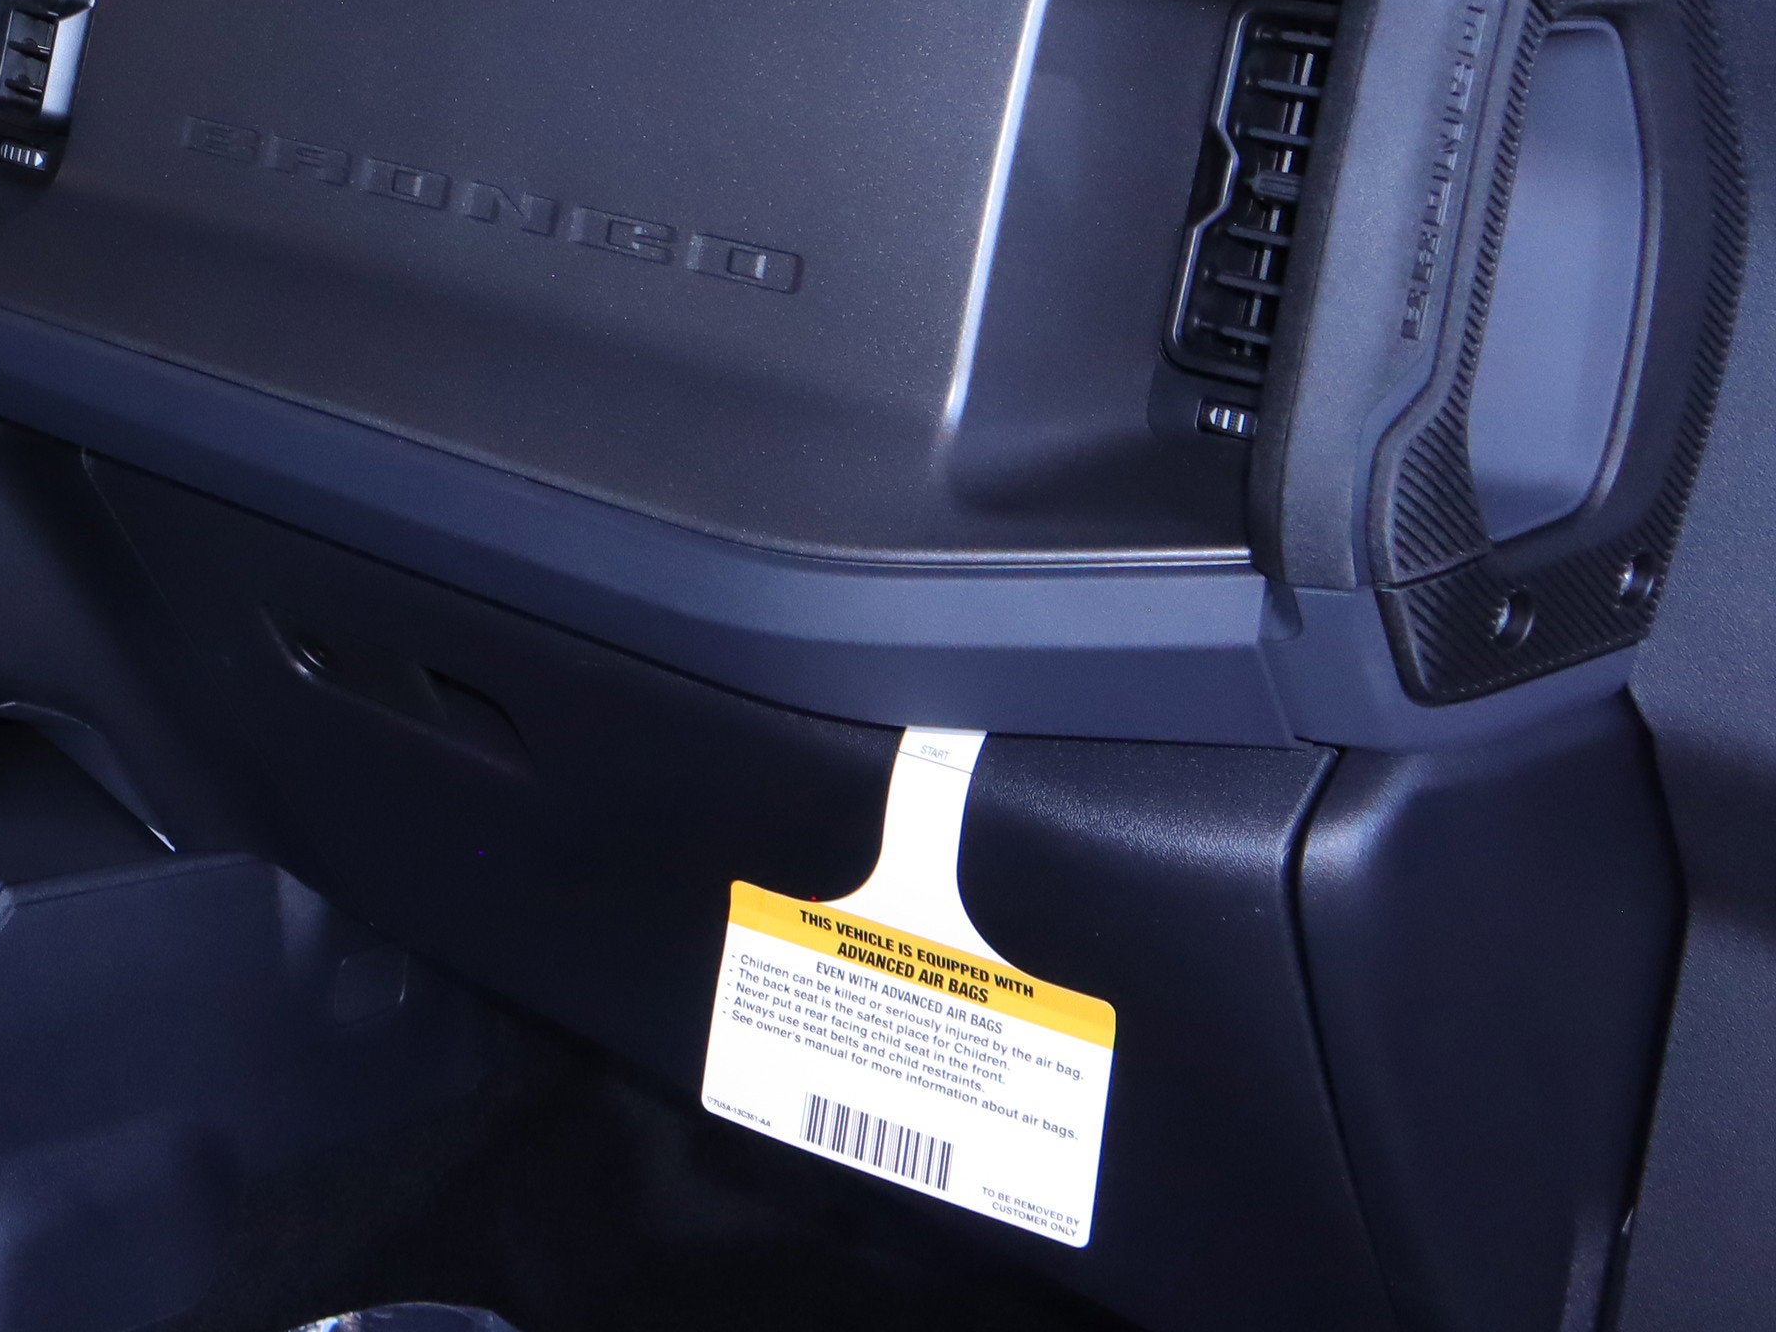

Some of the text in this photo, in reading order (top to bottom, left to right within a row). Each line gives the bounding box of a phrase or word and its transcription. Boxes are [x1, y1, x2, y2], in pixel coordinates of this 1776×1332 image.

[181, 113, 805, 296] BRONCO
[921, 745, 949, 761] START
[800, 910, 1035, 998] THIS VEHICLE IS EQUIPPED WITH
[816, 961, 1003, 1035] EVEN WITH ADVANCED AIR BAGS
[837, 942, 990, 1004] ADVANCED AIR BAGS
[733, 996, 985, 1093] Always use seat belts and child restraints.
[736, 982, 1005, 1084] Never put a rear facing child seat in the front.
[738, 967, 1011, 1071] The back seat is the safest place for Children.
[740, 954, 1085, 1081] Children can be killed or seriously injured by the air bag.
[731, 1009, 1078, 1141] See owner's manual for more information about air bags.
[982, 1186, 1081, 1227] TO BE REMOVED BY
[992, 1201, 1077, 1238] CUSTOMER ONLY
